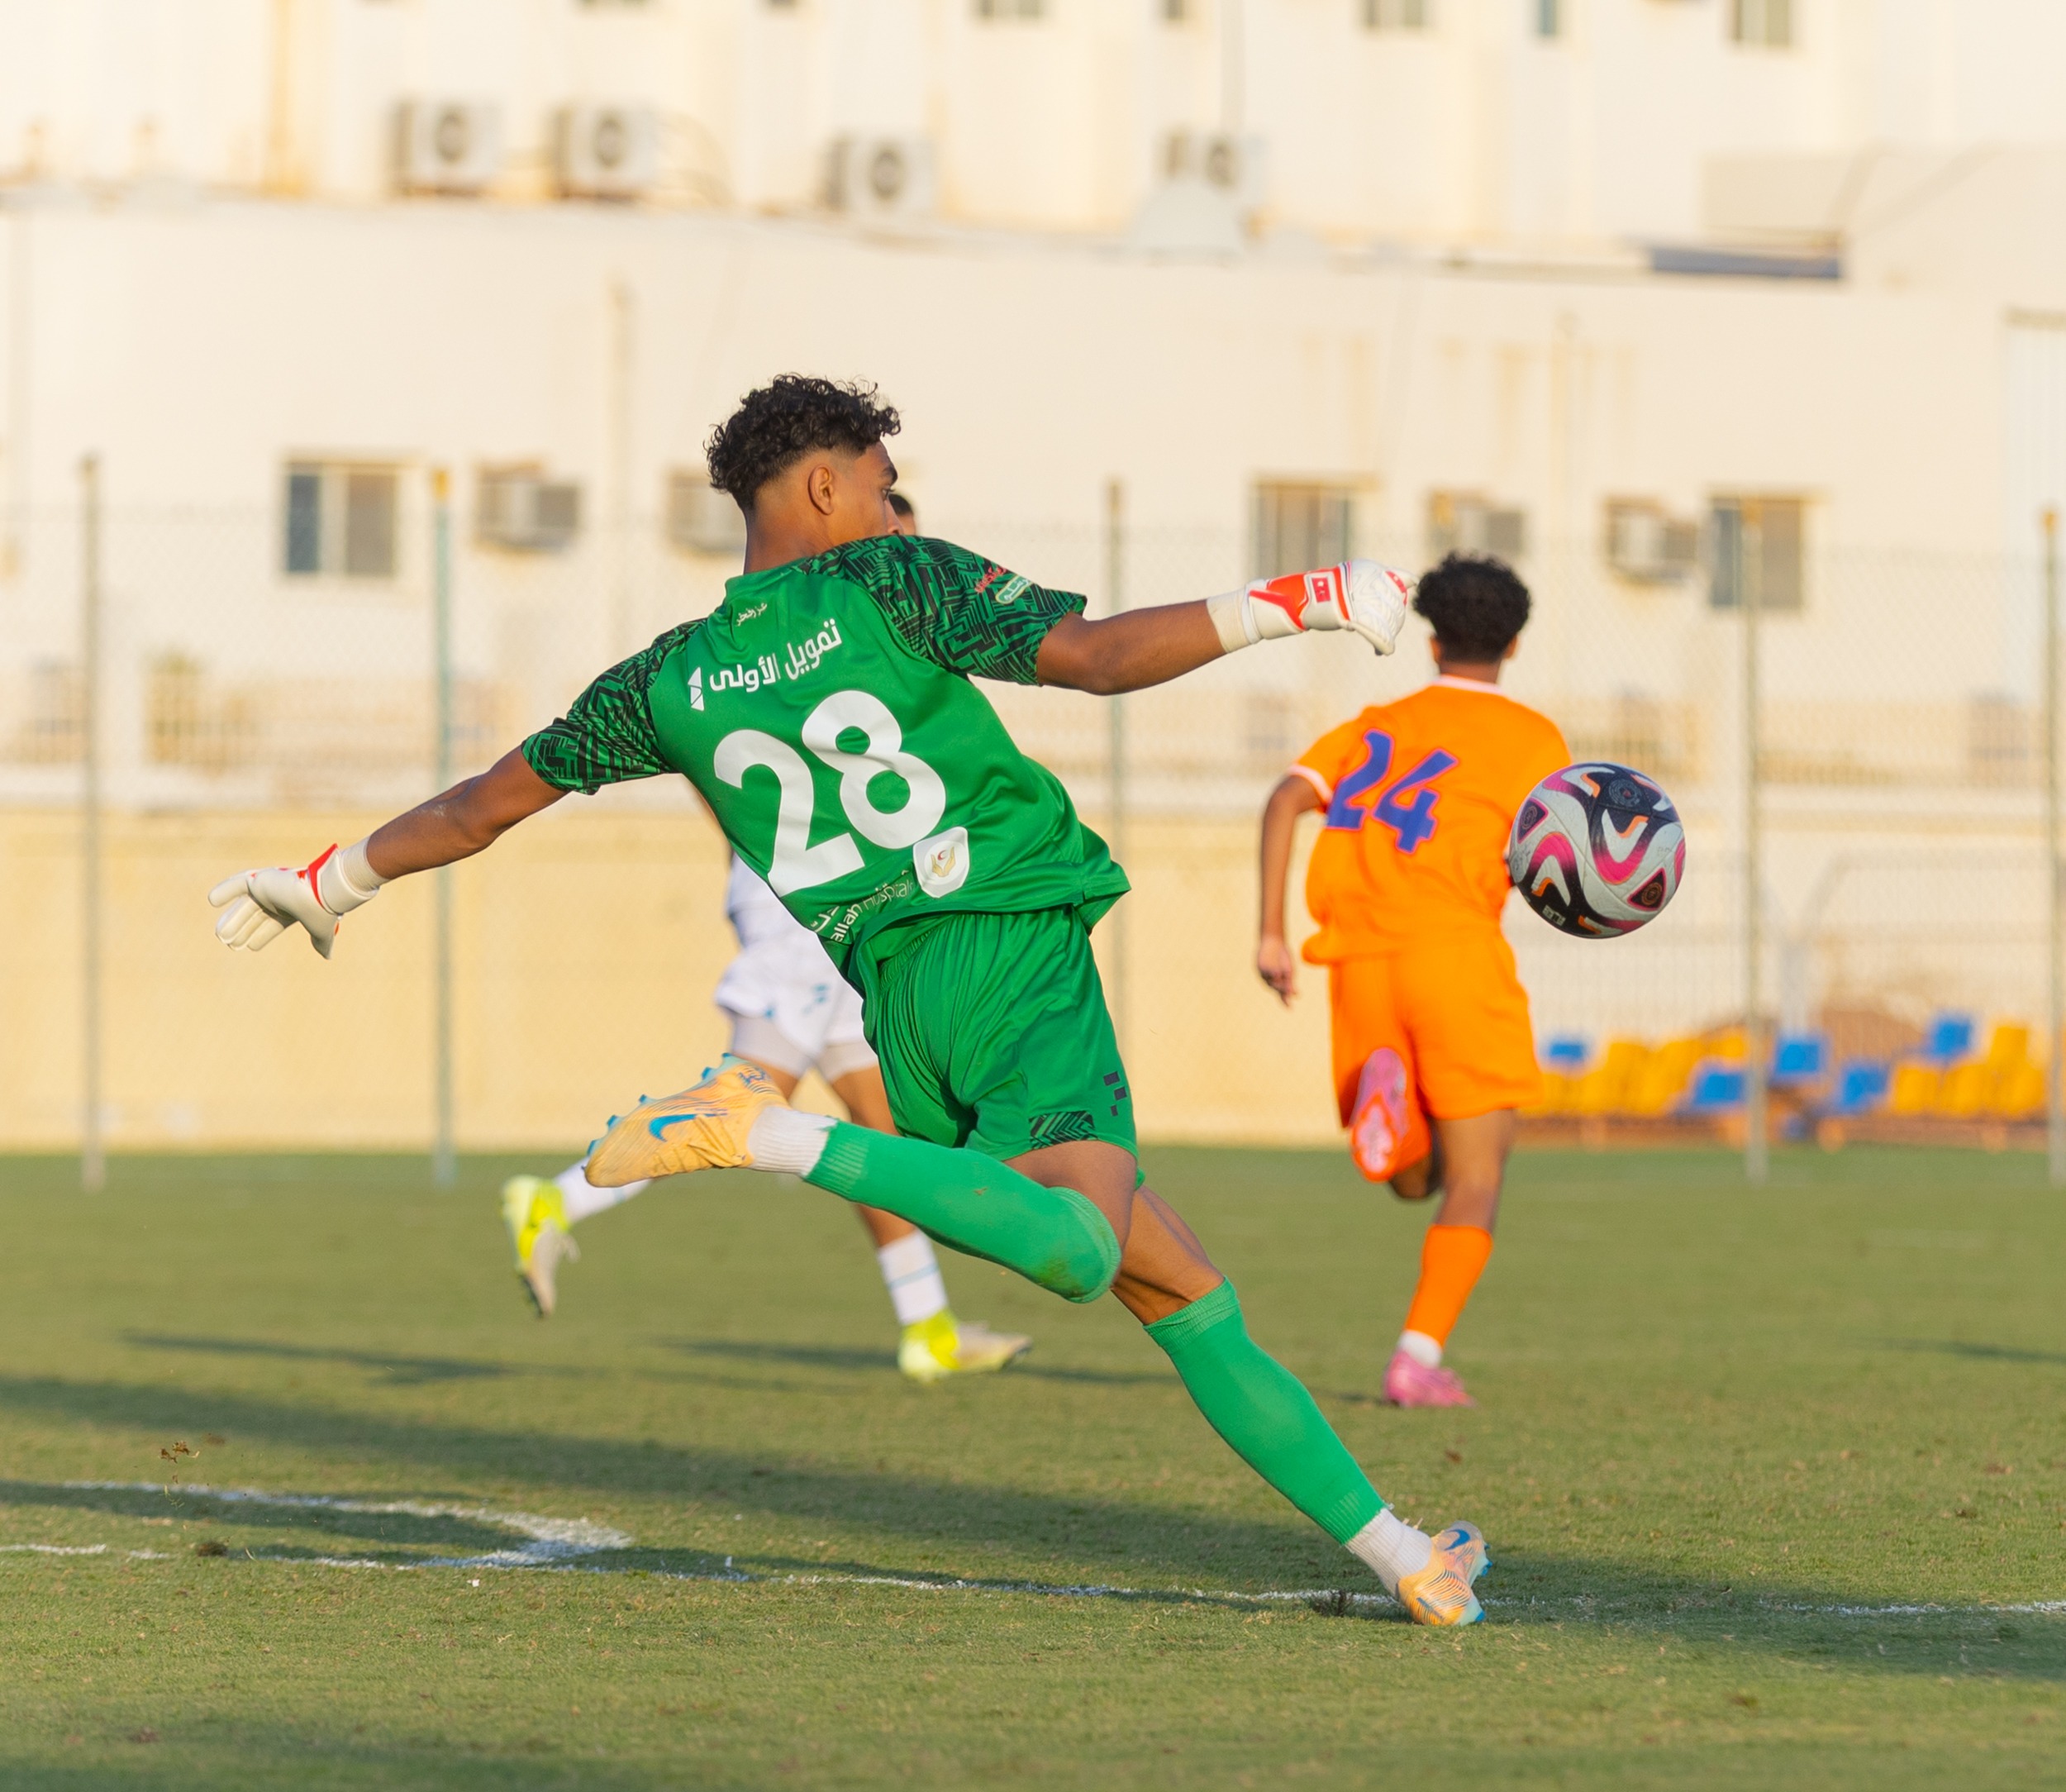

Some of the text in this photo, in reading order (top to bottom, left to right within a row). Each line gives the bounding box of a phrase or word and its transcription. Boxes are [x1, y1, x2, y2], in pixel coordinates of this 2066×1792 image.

[709, 618, 843, 693] تمويل الأولى
[712, 689, 946, 898] 28
[1325, 728, 1459, 854] 24
